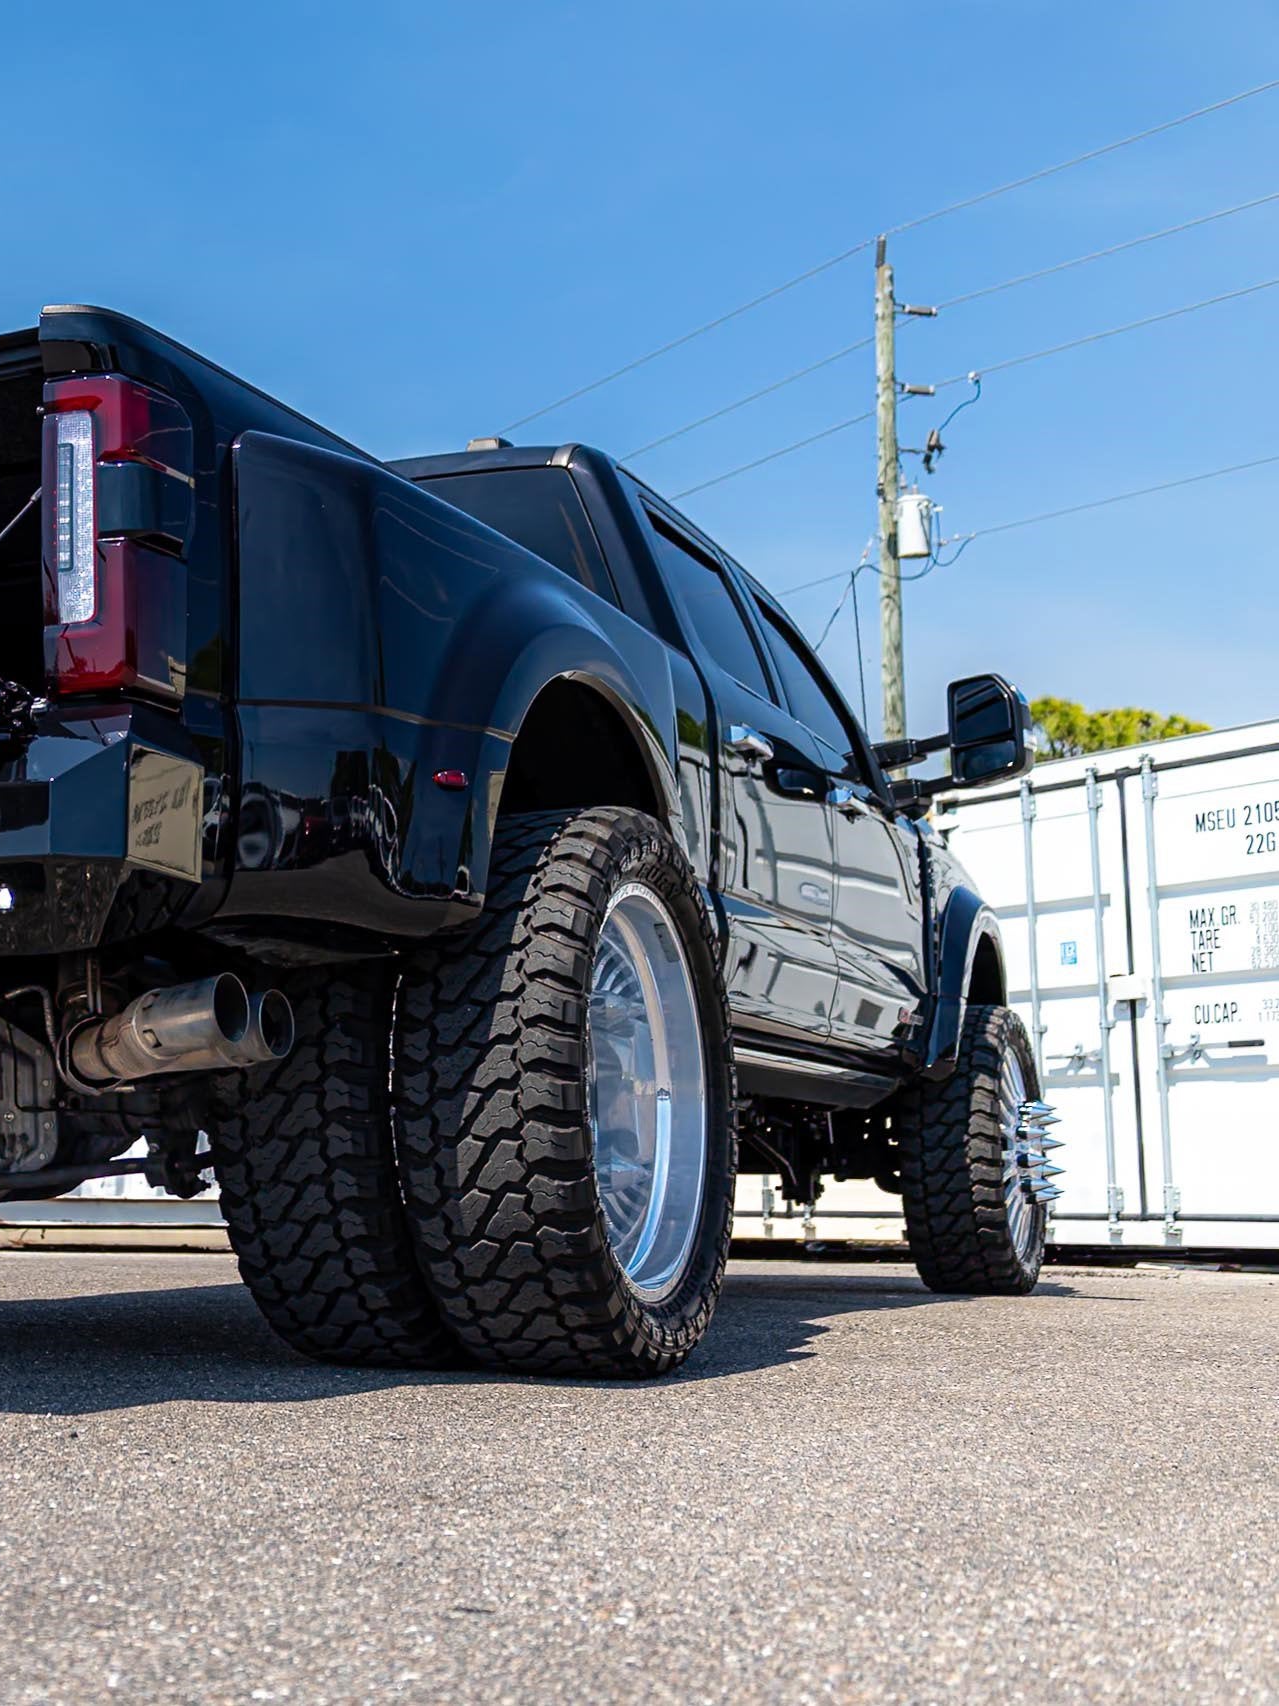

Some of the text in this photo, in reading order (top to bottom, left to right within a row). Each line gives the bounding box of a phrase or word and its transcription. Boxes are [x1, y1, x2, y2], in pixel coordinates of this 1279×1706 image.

[1195, 808, 1236, 832] MSEU
[1190, 928, 1221, 950] TARE
[1191, 951, 1213, 973] NET
